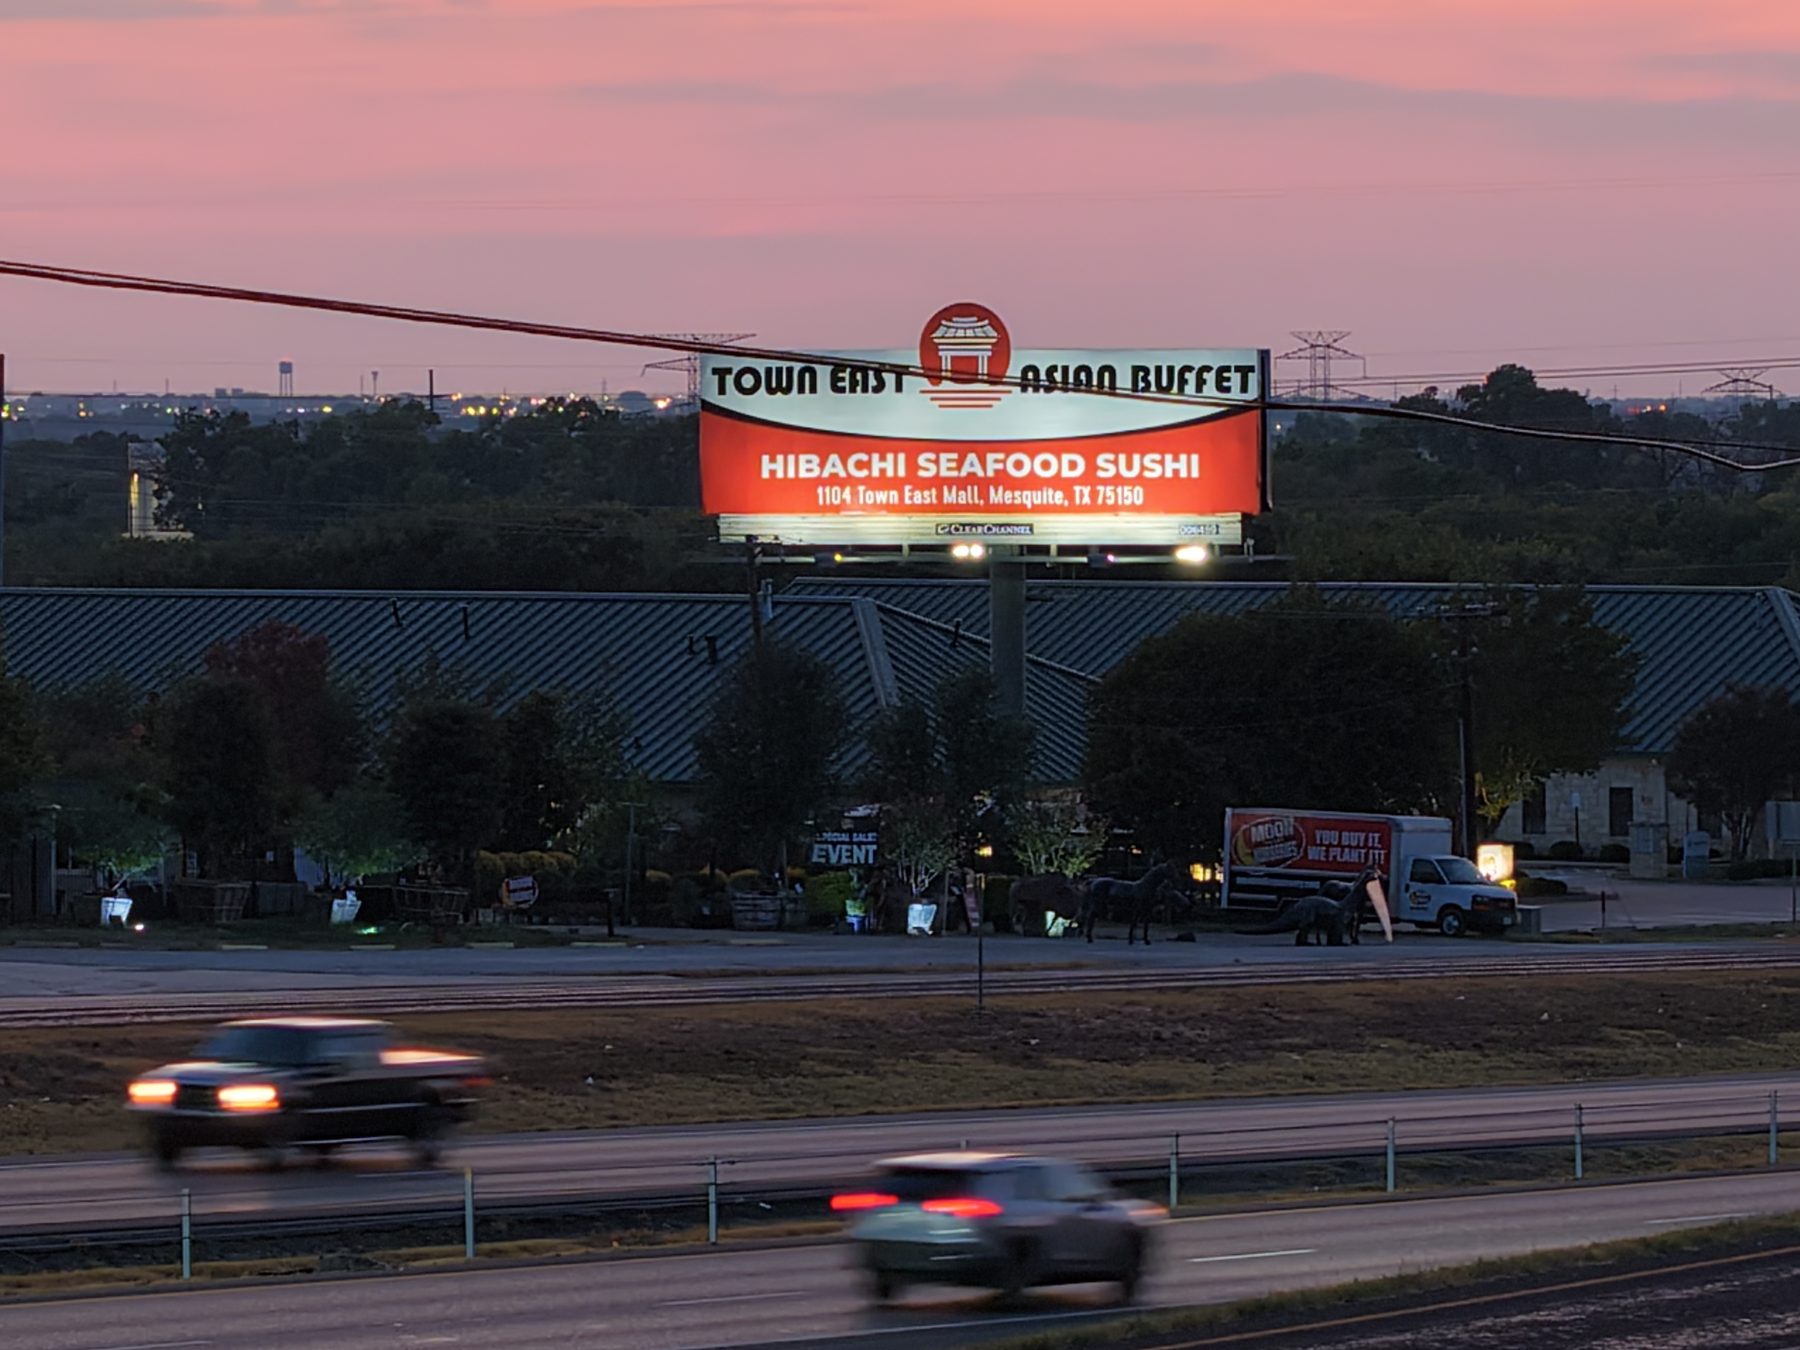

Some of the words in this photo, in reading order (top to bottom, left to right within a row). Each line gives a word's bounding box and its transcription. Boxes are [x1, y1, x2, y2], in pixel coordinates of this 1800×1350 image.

[711, 365, 818, 395] TOWN
[1020, 364, 1117, 393] ASIAN
[1131, 364, 1256, 394] BUFFET
[760, 452, 907, 479] HIBACHI
[917, 451, 1086, 479] SEAFOOD
[1096, 452, 1200, 479] SUSHI
[816, 485, 852, 506] 1104
[857, 485, 899, 505] Town
[904, 485, 937, 505] East
[943, 485, 984, 507] Mall,
[989, 485, 1069, 508] Mesquite,
[1073, 485, 1092, 506] TX
[1096, 485, 1145, 506] 75150
[1314, 829, 1340, 846] YOU
[1341, 831, 1366, 848] BUY
[811, 844, 878, 864] EVENT
[1307, 845, 1327, 862] WE
[1328, 846, 1367, 864] PLANT
